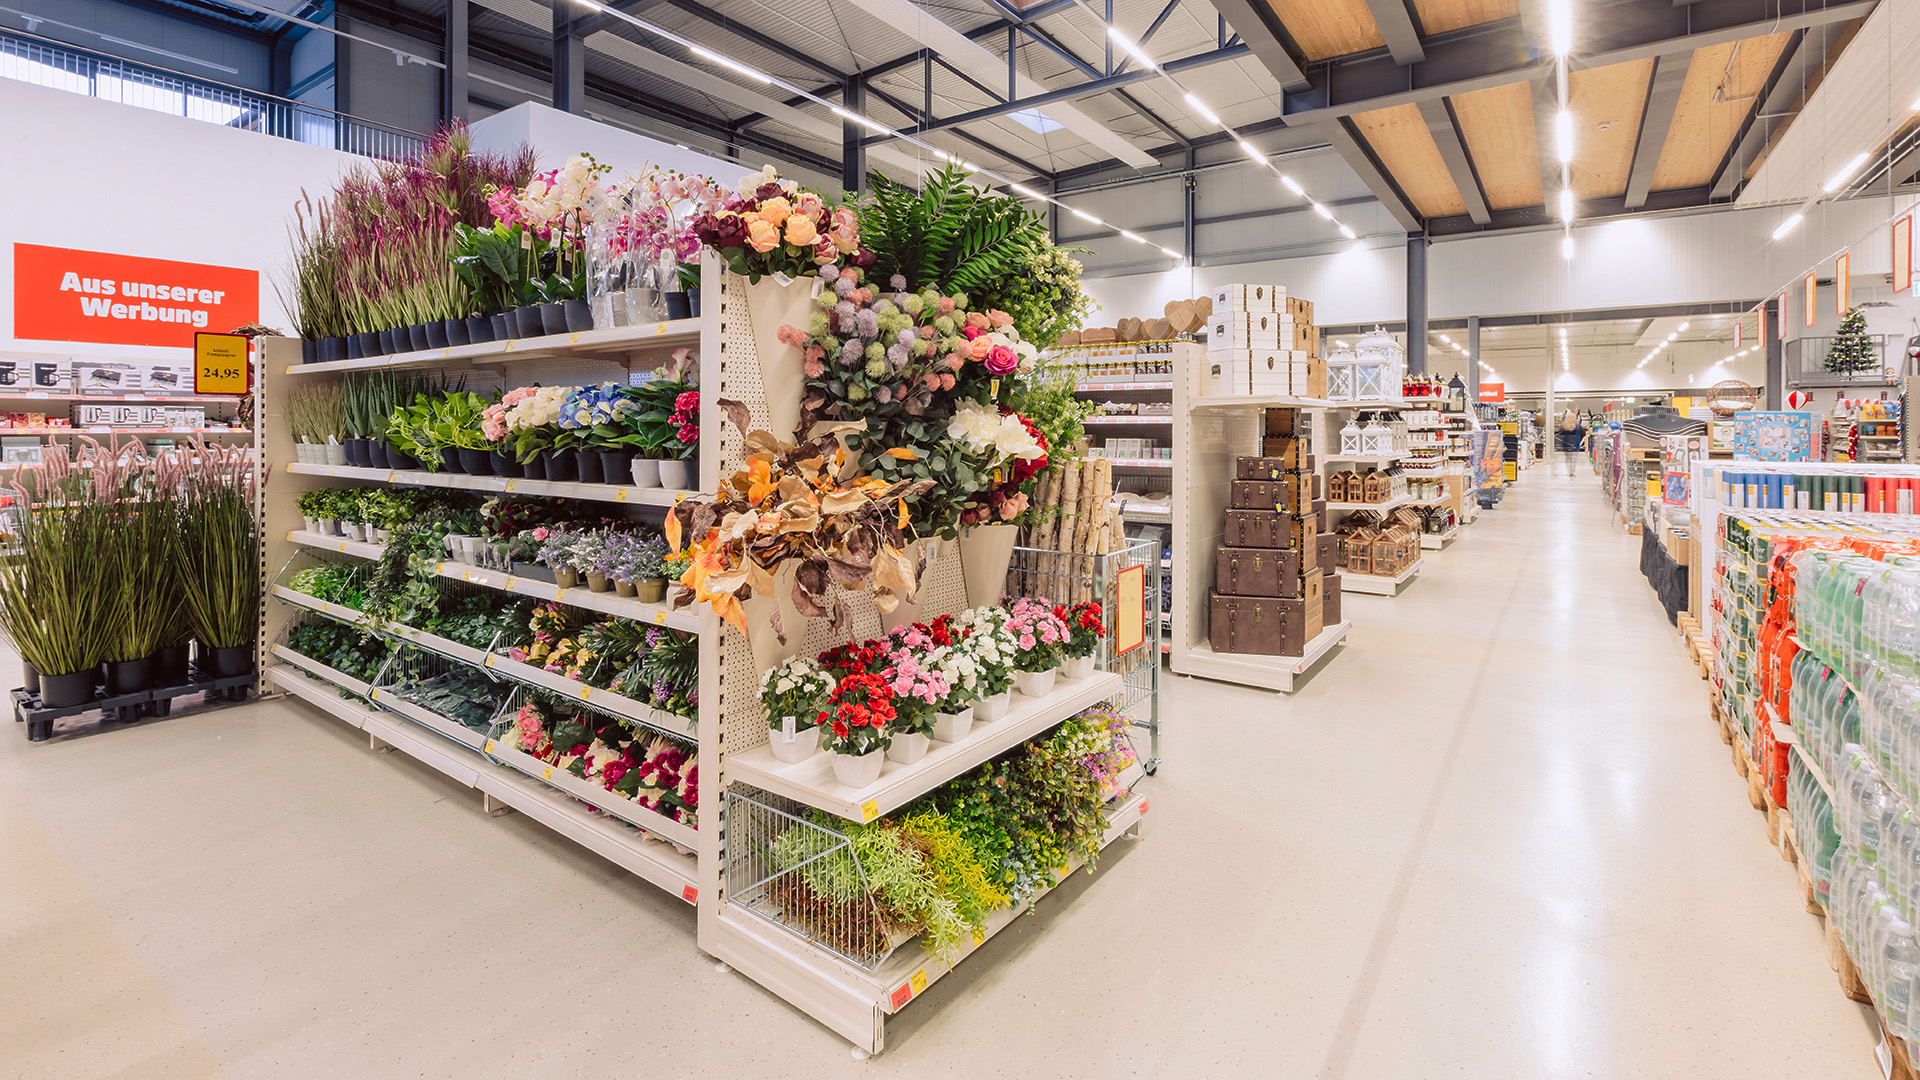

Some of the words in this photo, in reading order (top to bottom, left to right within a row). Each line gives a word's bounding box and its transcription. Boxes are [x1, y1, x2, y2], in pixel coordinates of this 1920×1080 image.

[60, 272, 116, 295] Aus
[122, 281, 225, 305] unserer
[80, 297, 208, 328] Werbung
[203, 367, 240, 380] 24,95
